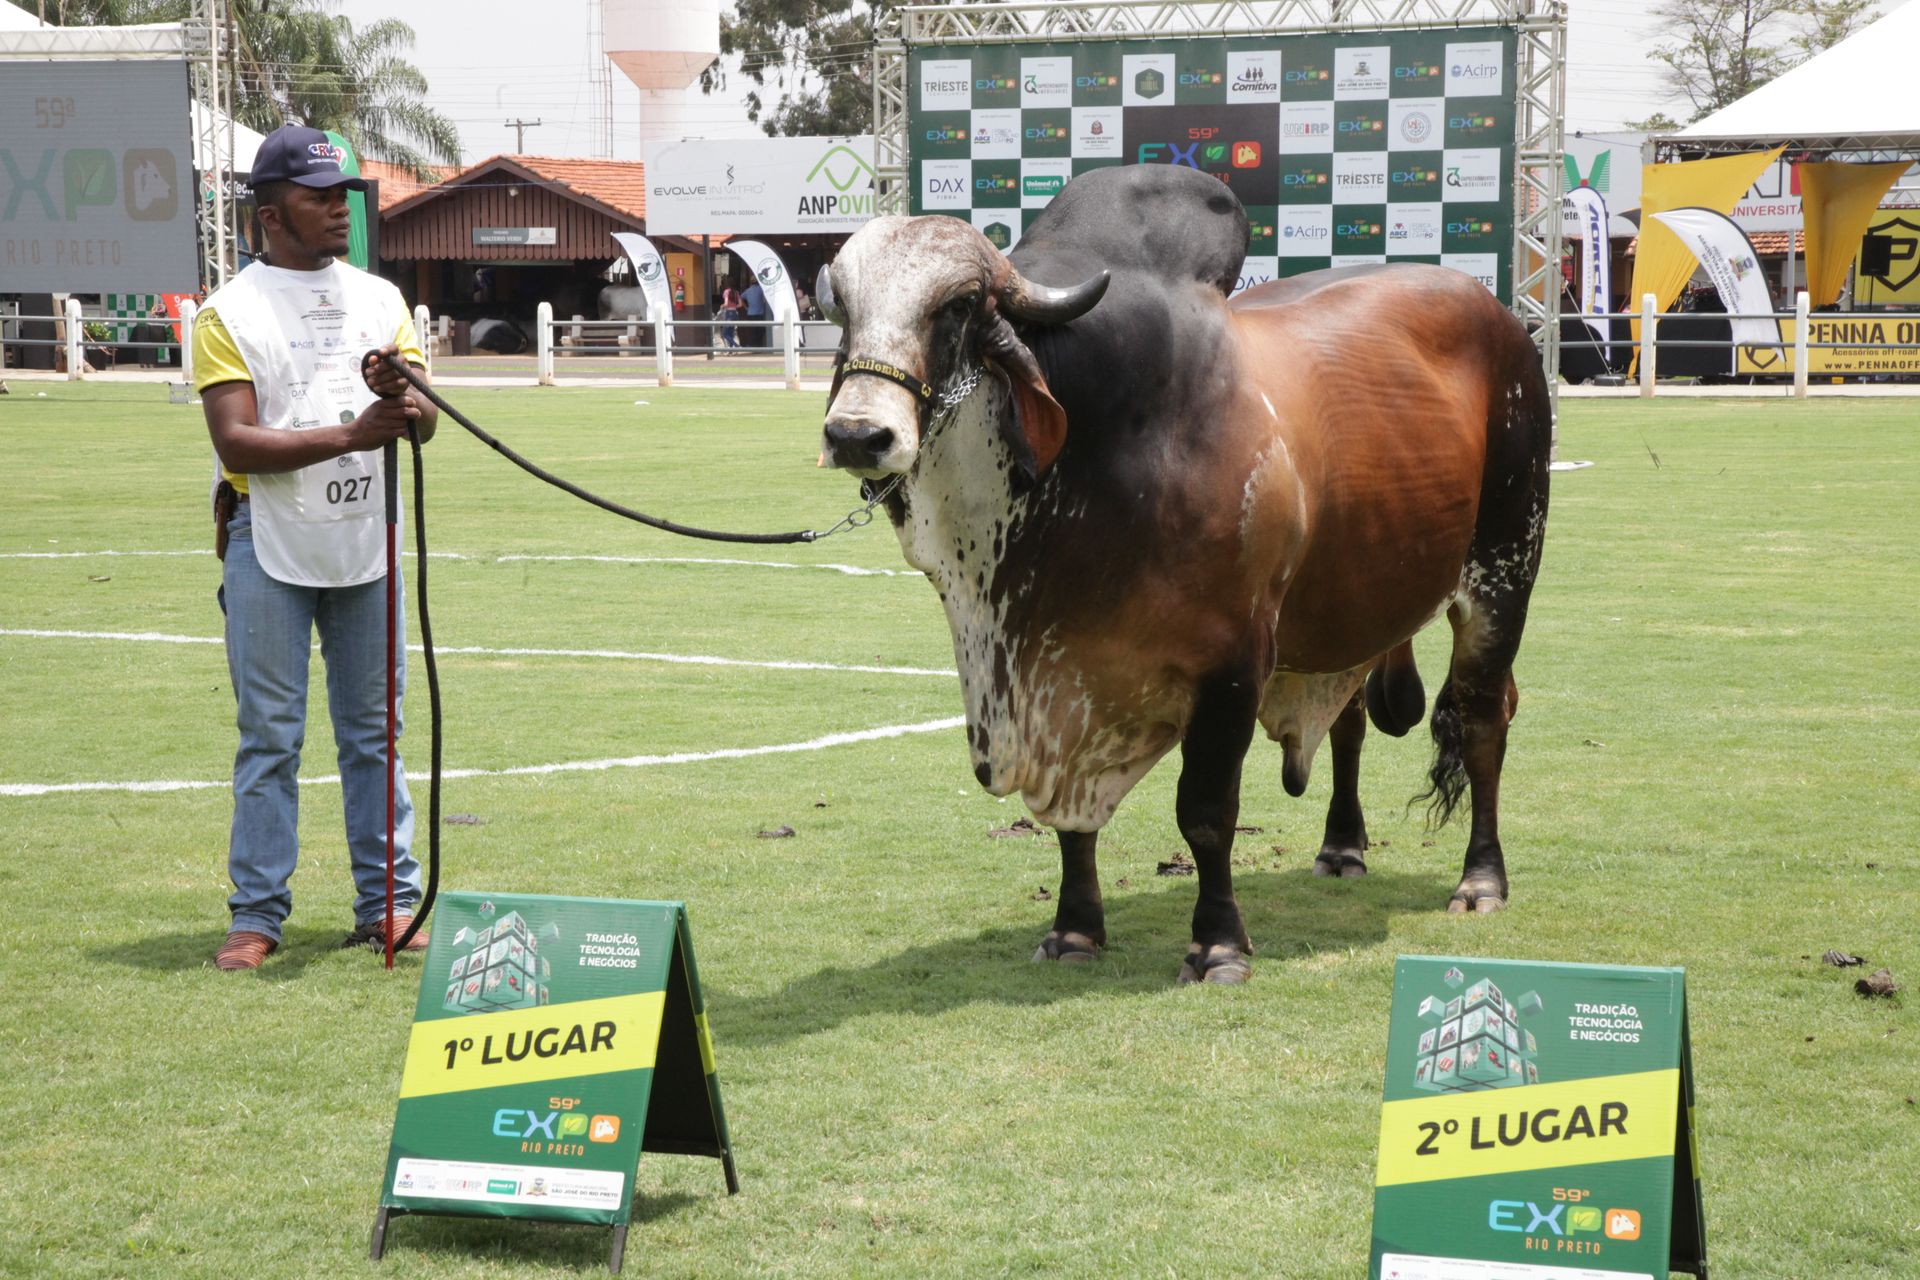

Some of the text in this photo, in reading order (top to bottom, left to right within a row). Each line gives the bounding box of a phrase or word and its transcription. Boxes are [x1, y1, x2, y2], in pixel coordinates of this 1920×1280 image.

[1463, 64, 1498, 78] Acirp
[1232, 82, 1277, 91] Comitiva
[653, 186, 707, 196] EVOLVE
[929, 178, 964, 193] DAX
[1294, 225, 1328, 239] Acirp
[7, 239, 121, 266] RIO PRETO
[1832, 347, 1918, 356] Acessórios off-road
[851, 359, 905, 381] Quilombo
[326, 476, 372, 504] 027
[586, 933, 639, 946] TRADIÇÃO,
[579, 944, 641, 957] TECNOLOGIA
[579, 956, 637, 969] E NEGÓCIOS
[1575, 1003, 1639, 1018] TRADIÇÃO,
[1569, 1016, 1643, 1030] TECNOLOGIA
[1570, 1029, 1640, 1043] E NEGÓCIOS
[443, 1021, 617, 1070] 1º LUGAR
[492, 1108, 621, 1144] EXPO
[1416, 1101, 1629, 1156] 2º LUGAR
[521, 1141, 584, 1156] RIO PRETO
[1488, 1199, 1641, 1241] EXPO
[1525, 1237, 1601, 1255] RIO PRETO
